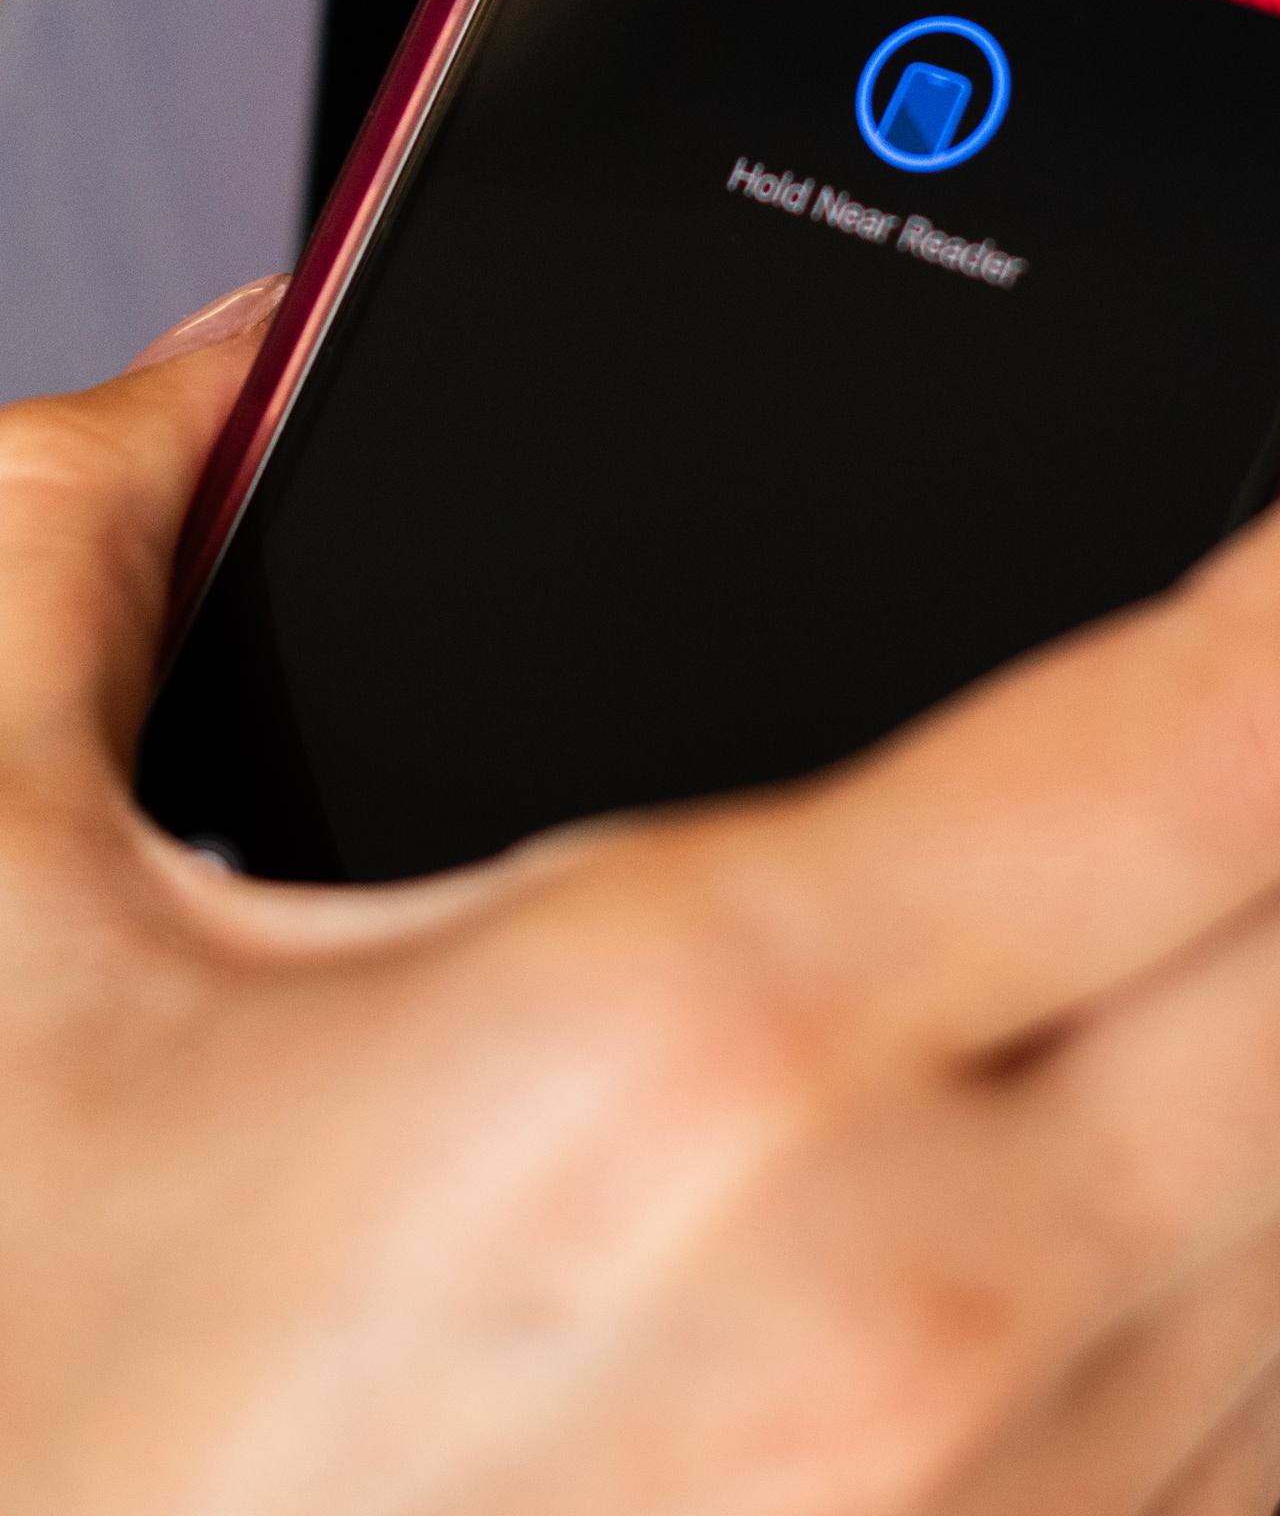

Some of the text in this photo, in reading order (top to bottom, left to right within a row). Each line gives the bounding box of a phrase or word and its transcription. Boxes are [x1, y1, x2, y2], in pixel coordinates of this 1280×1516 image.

[725, 155, 1031, 289] Hold Near Reader
